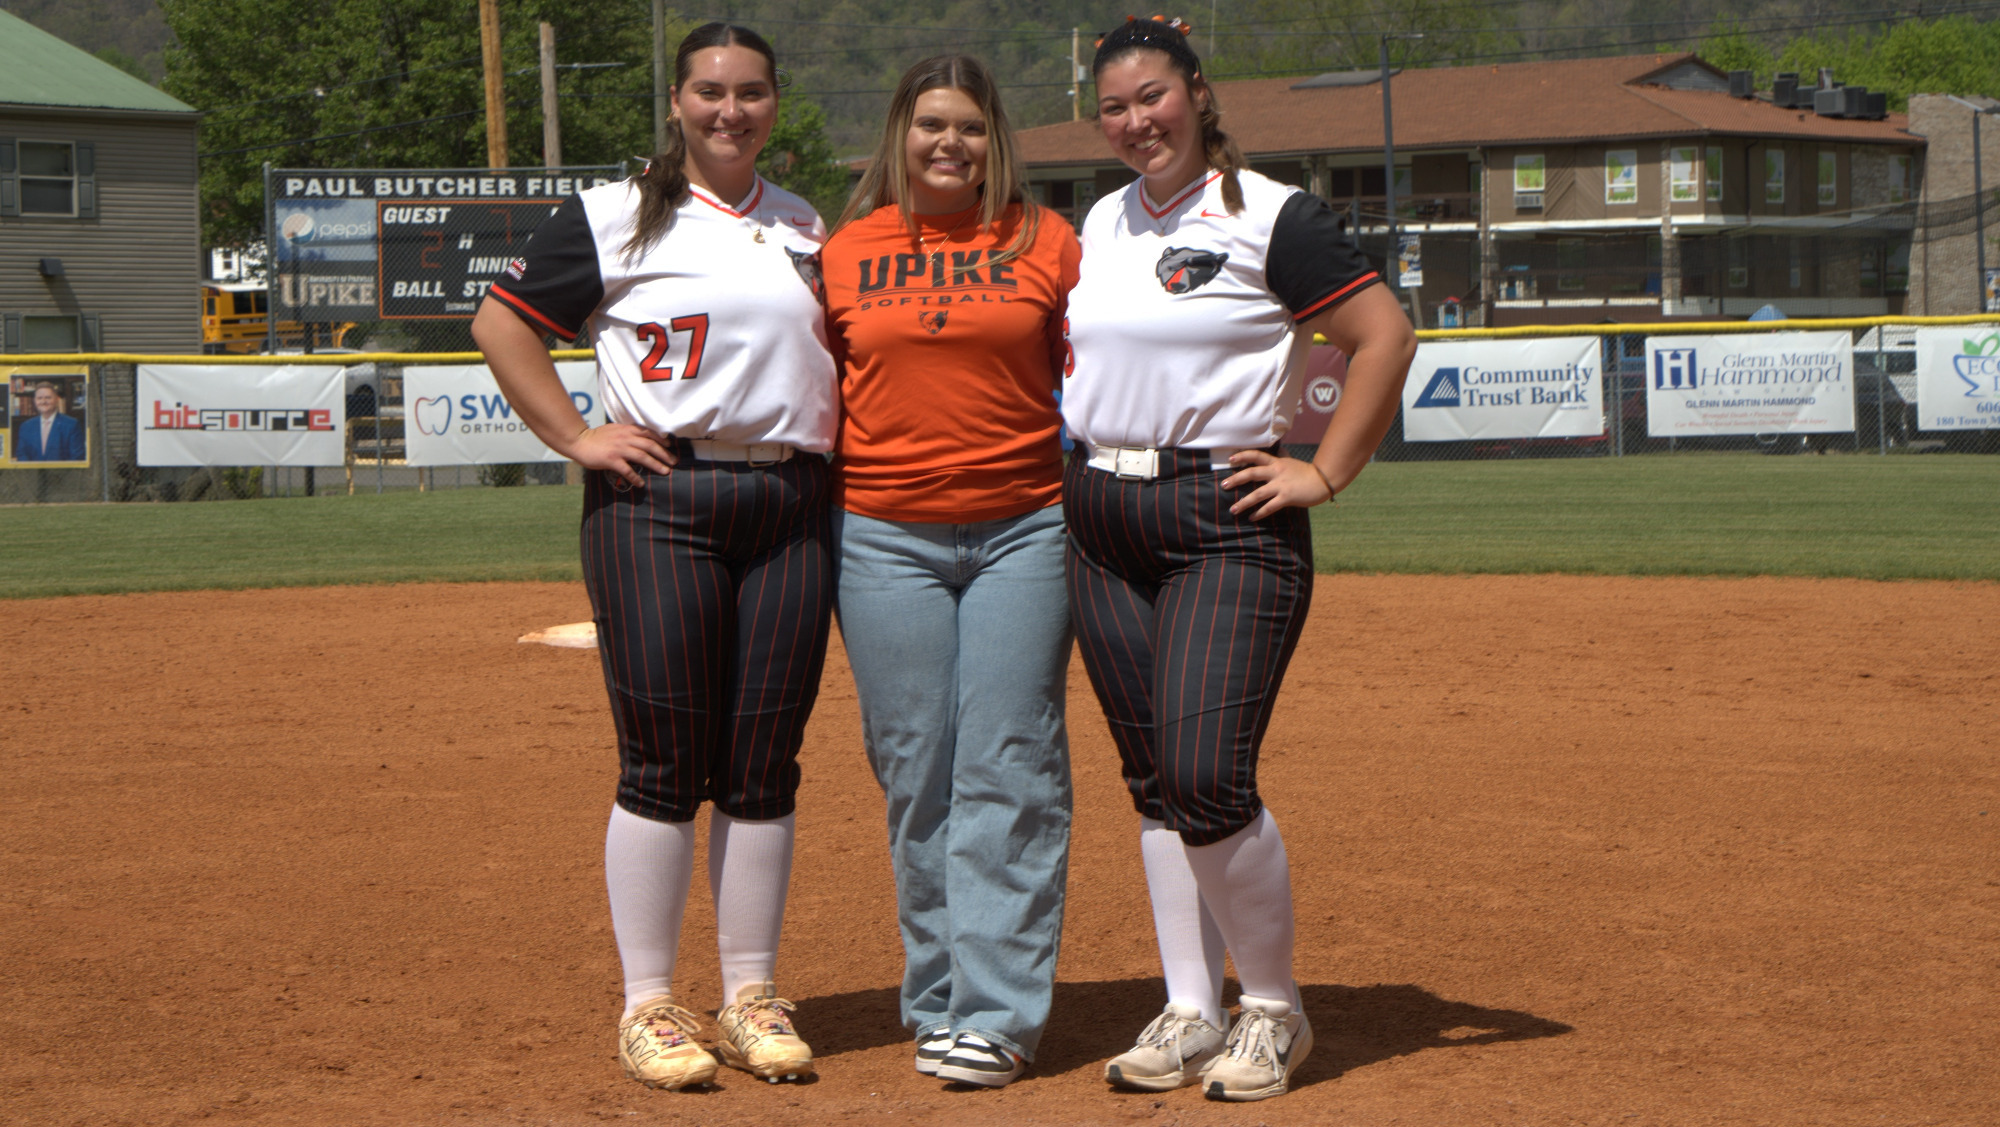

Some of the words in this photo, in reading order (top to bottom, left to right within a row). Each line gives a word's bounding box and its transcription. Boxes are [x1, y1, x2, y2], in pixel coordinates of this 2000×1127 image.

[286, 178, 364, 196] PAUL
[374, 178, 516, 196] BUTCHER
[383, 207, 451, 224] GUEST
[319, 221, 372, 238] pepsi
[458, 233, 474, 249] H
[467, 257, 517, 273] INNI
[858, 249, 1018, 294] UPIKE
[280, 273, 376, 307] UPIKE
[392, 281, 446, 297] BALL
[860, 293, 1013, 311] SOFTBALL
[636, 312, 710, 383] 27
[1722, 353, 1775, 368] Glenn
[1780, 351, 1836, 367] Martin
[1967, 358, 2000, 375] EC
[1463, 363, 1594, 386] Community
[1701, 361, 1842, 386] Hammond
[1531, 384, 1588, 405] Bank
[1686, 399, 1720, 408] GLENN
[1722, 398, 1760, 407] MARTIN
[1763, 397, 1816, 406] HAMMOND
[460, 391, 594, 421] SWD
[153, 400, 334, 432] bitsource
[1936, 415, 1955, 426] 180
[1957, 415, 1987, 425] Town
